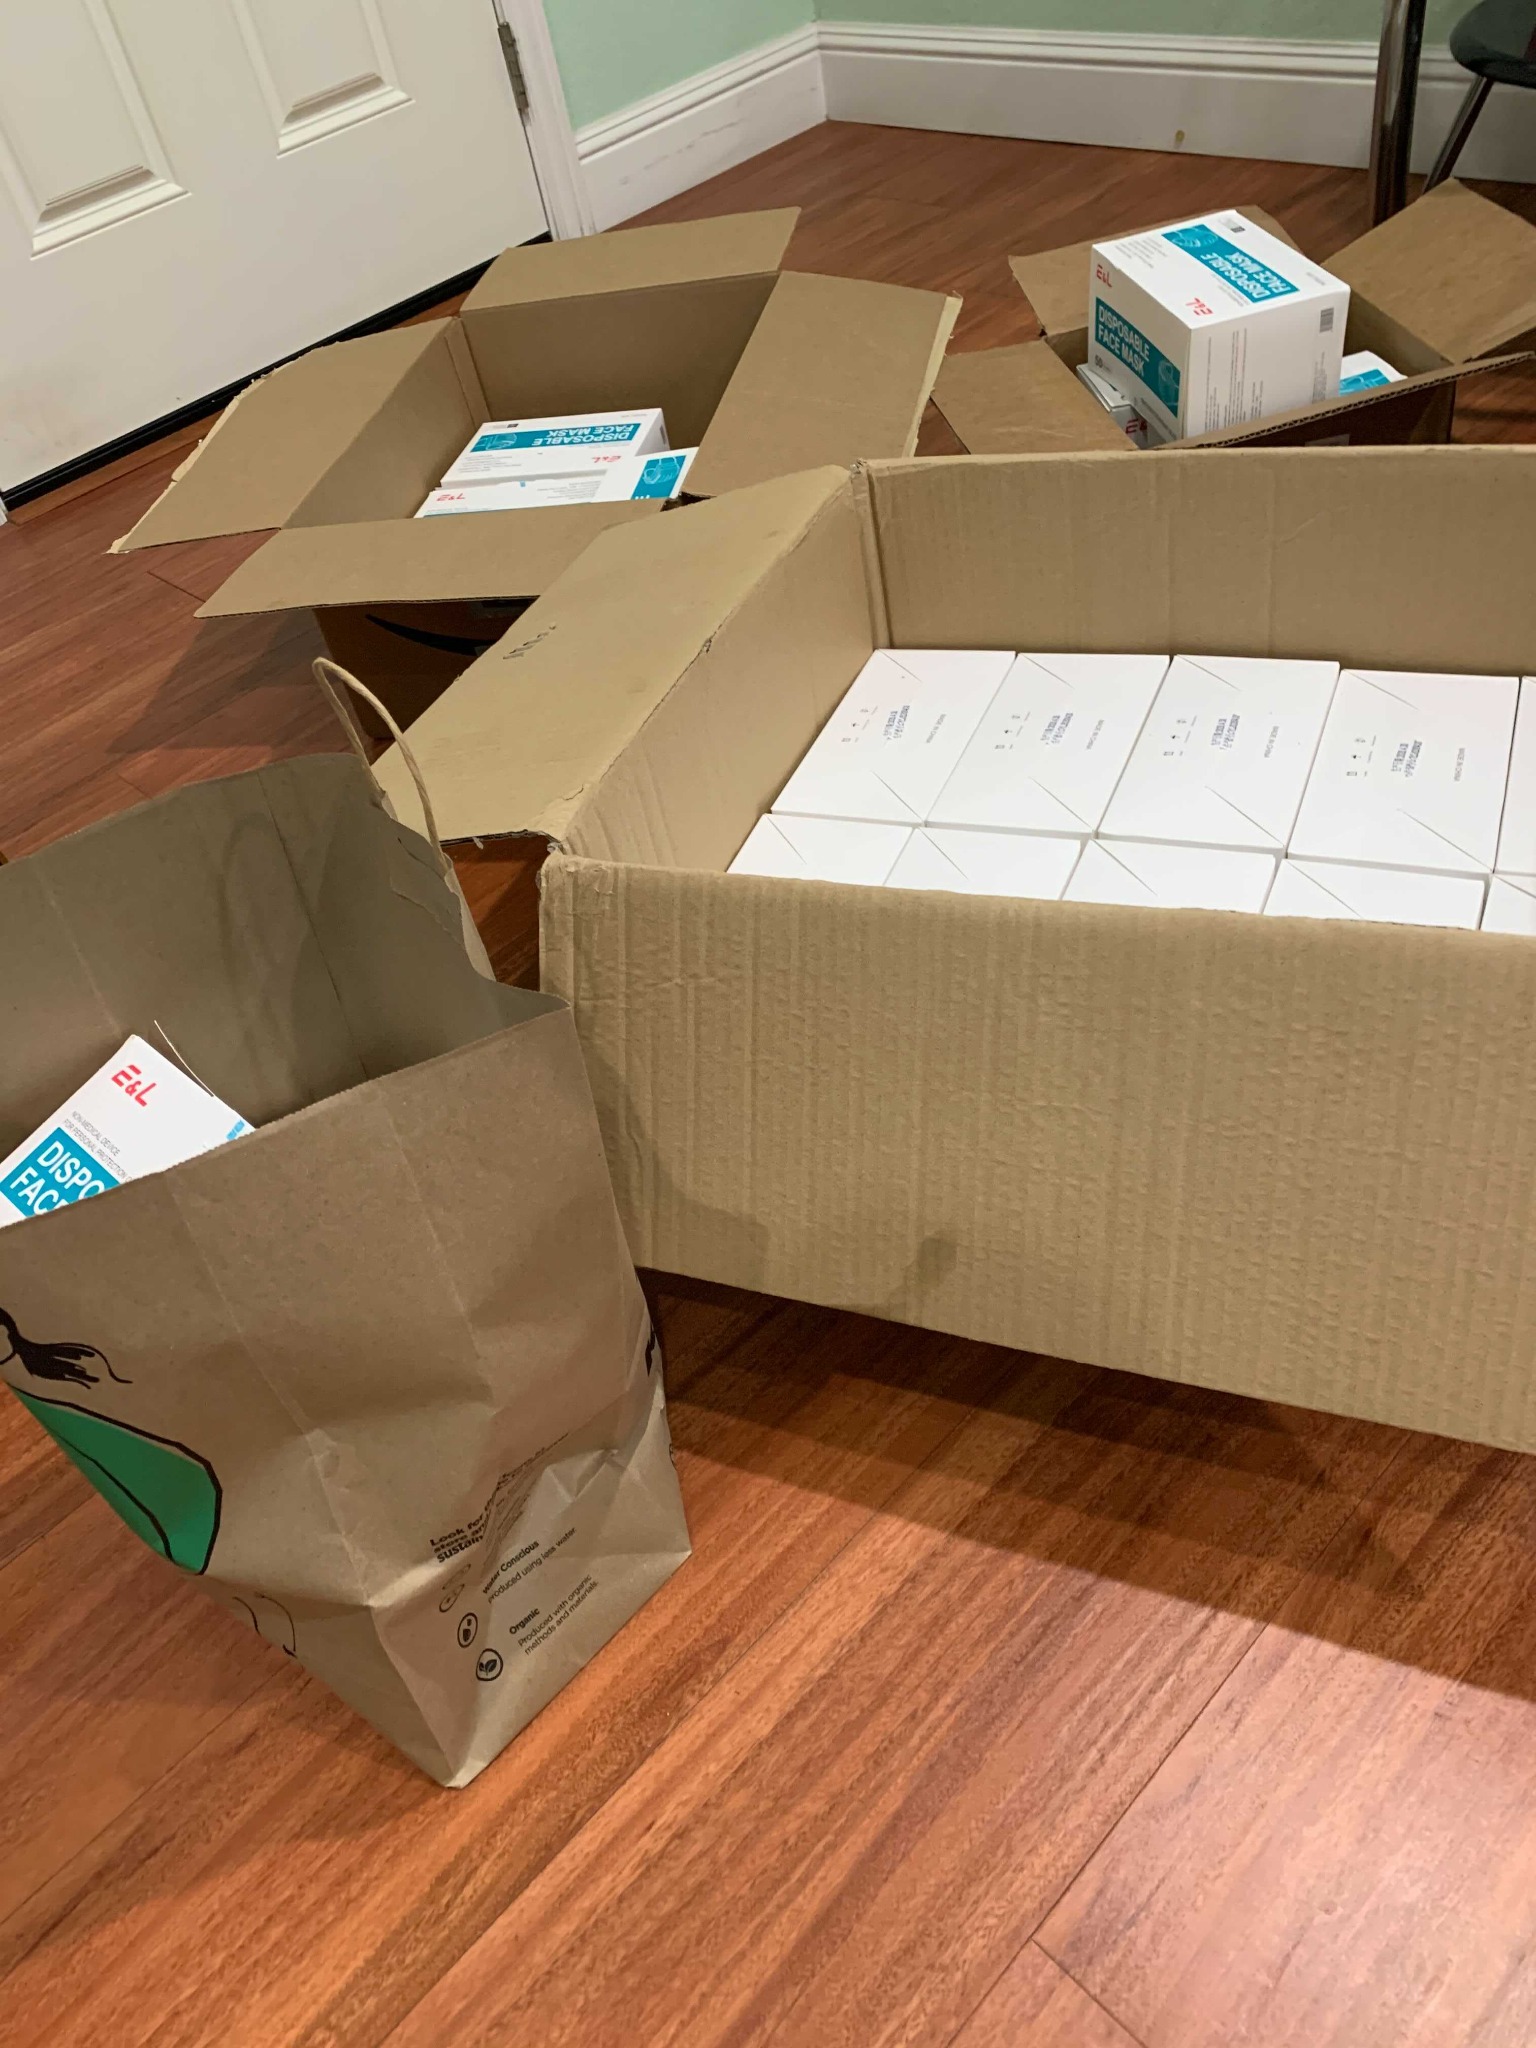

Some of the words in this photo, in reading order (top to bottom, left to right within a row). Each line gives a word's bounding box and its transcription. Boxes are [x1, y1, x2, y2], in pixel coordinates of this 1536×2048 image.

[1201, 252, 1271, 299] DISPOSABLE
[1225, 252, 1265, 273] MASK
[1253, 270, 1291, 293] FACE
[1098, 305, 1150, 362] DISPOSABLE
[1098, 324, 1121, 355] FACE
[1121, 343, 1145, 377] MASK
[532, 431, 630, 446] DISPOSABLE
[546, 427, 592, 438] MASK
[593, 424, 635, 433] FACE
[111, 1064, 156, 1107] E&L
[9, 1166, 69, 1215] FAC
[430, 1528, 465, 1546] Look
[500, 1540, 540, 1572] Conscious
[521, 1557, 543, 1577] using
[541, 1546, 556, 1560] less
[508, 1608, 540, 1635] Organic
[518, 1614, 554, 1648] Produced
[552, 1600, 569, 1617] with
[567, 1574, 592, 1601] organic
[524, 1625, 557, 1656] methods
[556, 1610, 570, 1627] and
